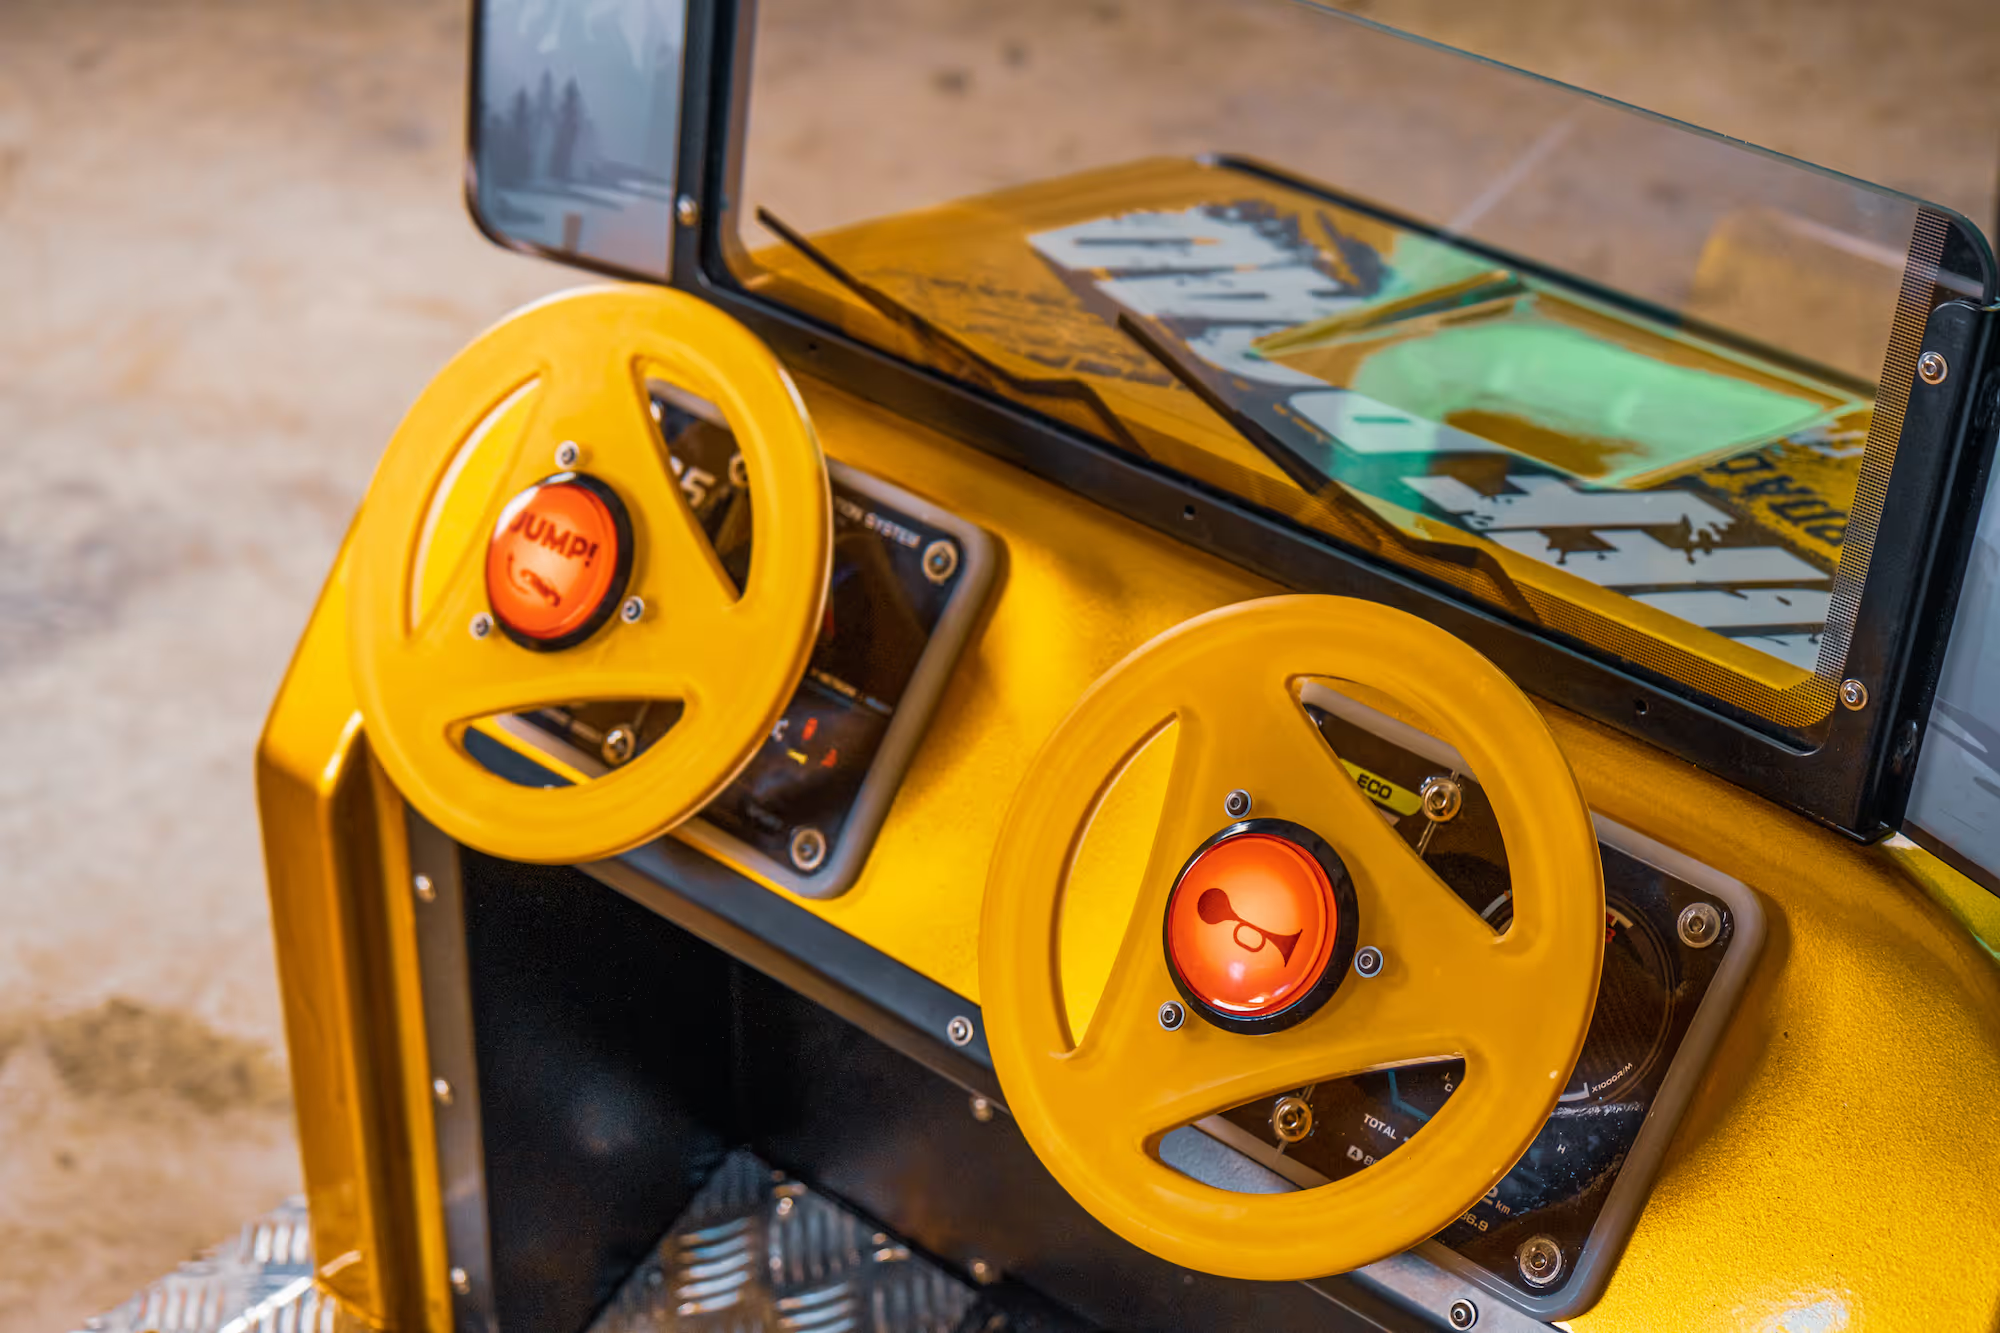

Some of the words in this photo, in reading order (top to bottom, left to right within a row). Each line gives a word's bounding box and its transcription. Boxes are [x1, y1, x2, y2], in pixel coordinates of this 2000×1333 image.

[510, 511, 599, 568] JUMP!
[1356, 772, 1393, 800] ECO
[1363, 1112, 1397, 1140] TOTAL
[1556, 1143, 1566, 1154] H
[1495, 1200, 1511, 1216] km
